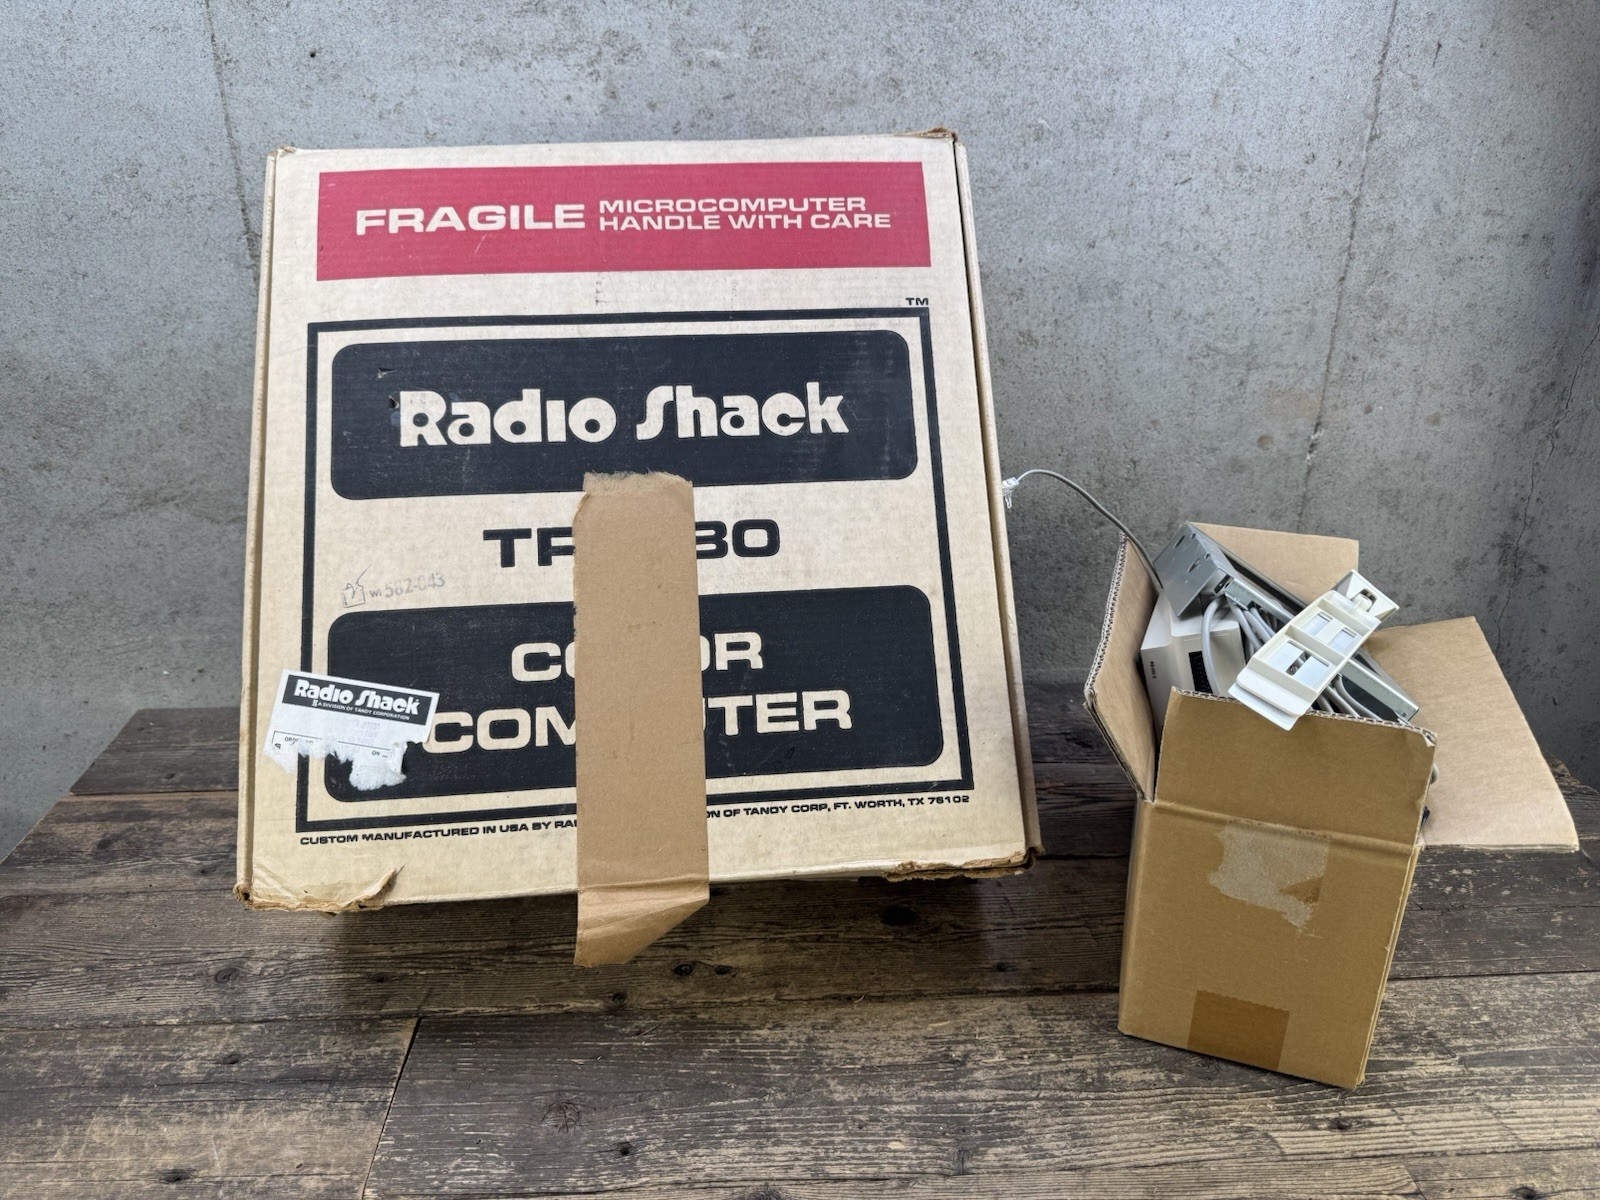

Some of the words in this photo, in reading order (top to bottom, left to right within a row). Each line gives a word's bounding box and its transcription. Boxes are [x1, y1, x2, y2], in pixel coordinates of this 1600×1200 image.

[599, 197, 866, 213] MICROCOMPUTER
[356, 204, 586, 235] FRAGILE
[599, 214, 721, 231] HANDLE
[727, 215, 803, 230] WITH
[810, 213, 892, 229] CARE
[905, 297, 929, 306] TM
[400, 388, 617, 447] Radio
[635, 382, 849, 441] Shack
[294, 679, 354, 703] Radio
[355, 690, 420, 715] Shack
[323, 703, 347, 711] DIVISION
[373, 710, 411, 721] CORPORATION
[723, 808, 741, 818] OF
[744, 805, 788, 816] TANDY
[833, 800, 852, 810] FT.
[907, 797, 924, 806] TX
[300, 834, 358, 846] CUSTOM
[362, 826, 479, 842] MANUFACTURED
[482, 825, 496, 834] IN
[499, 823, 529, 833] USA
[532, 821, 552, 830] BY
